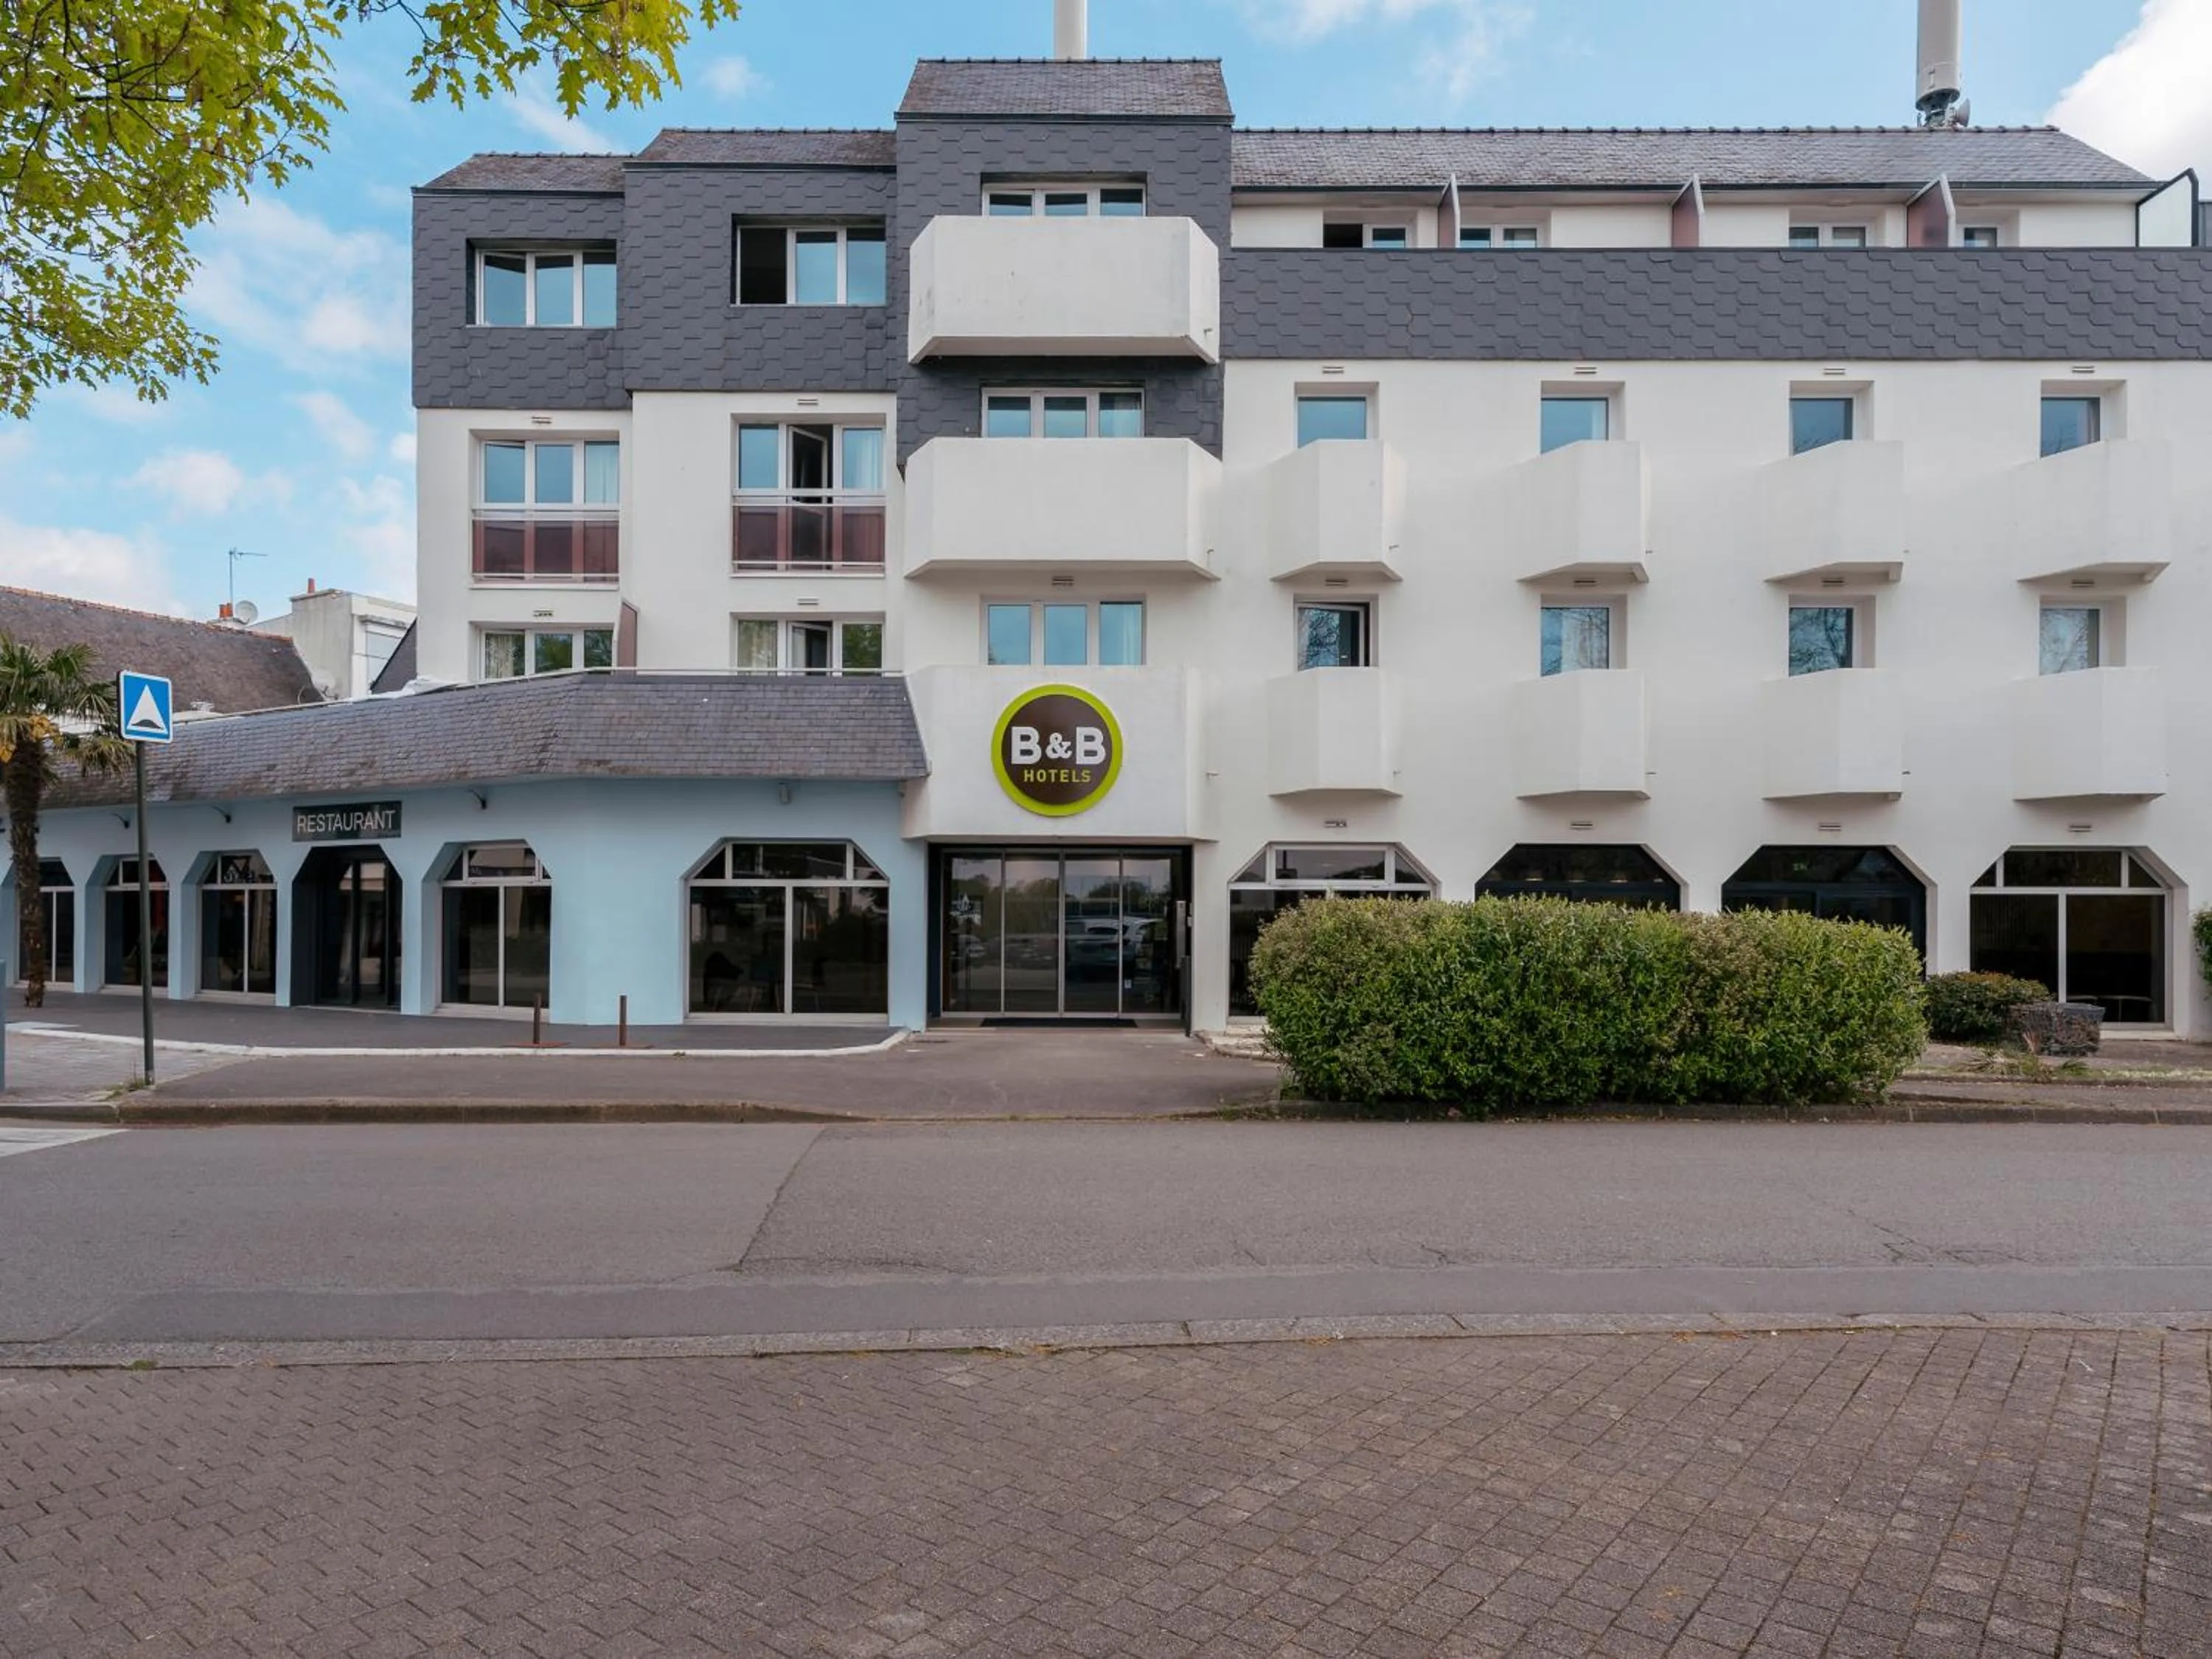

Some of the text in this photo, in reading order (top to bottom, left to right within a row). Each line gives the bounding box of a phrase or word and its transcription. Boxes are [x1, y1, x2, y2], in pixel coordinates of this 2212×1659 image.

[1011, 726, 1106, 764] B&B
[1023, 769, 1091, 782] HOTELS
[296, 810, 396, 834] RESTAURANT
